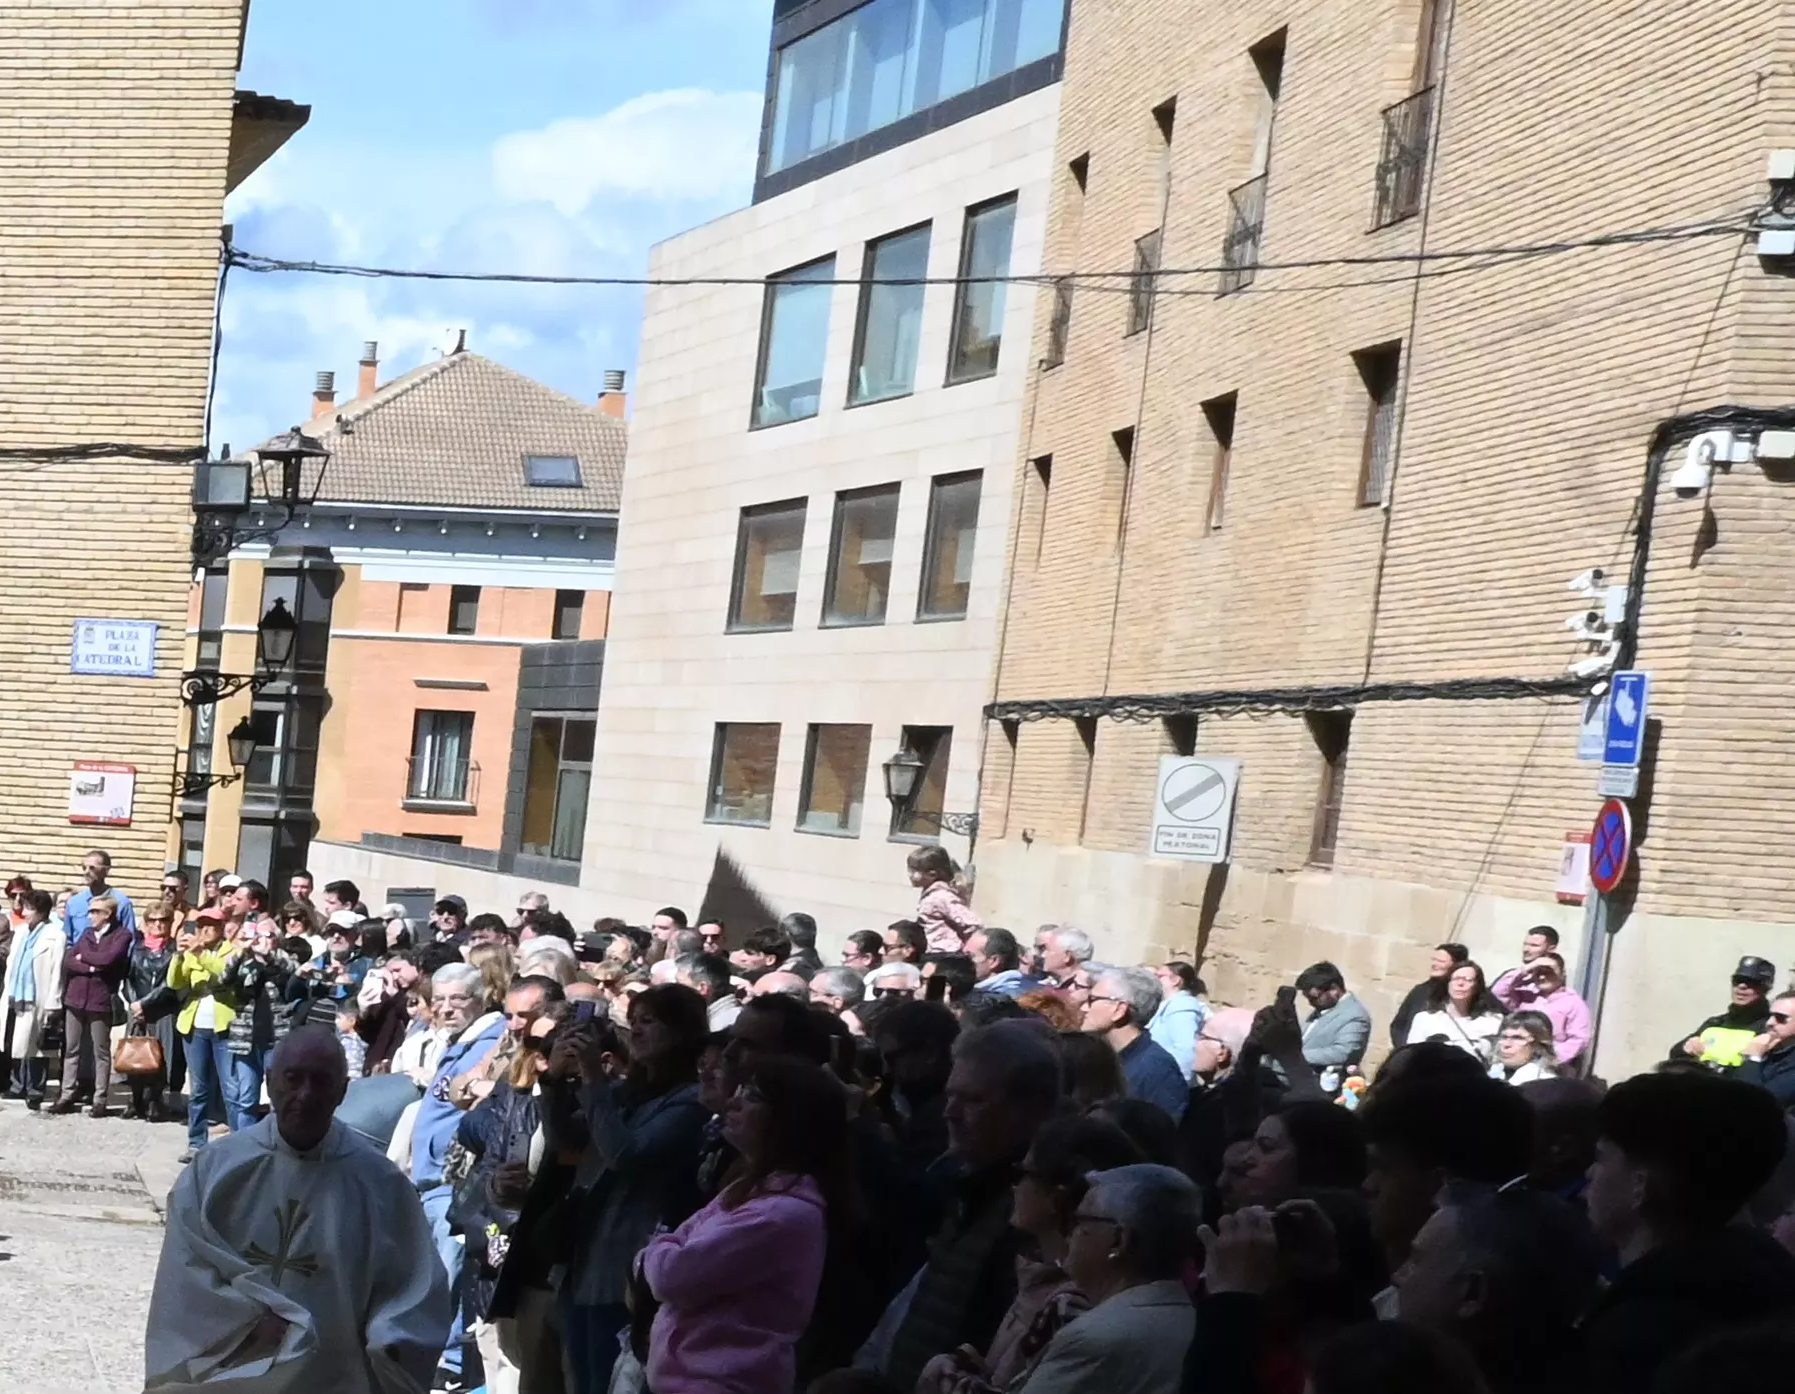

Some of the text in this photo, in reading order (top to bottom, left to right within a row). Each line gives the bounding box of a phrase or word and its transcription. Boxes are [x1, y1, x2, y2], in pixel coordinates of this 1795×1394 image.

[106, 630, 140, 640] PLAZA
[108, 643, 136, 652] DE LA
